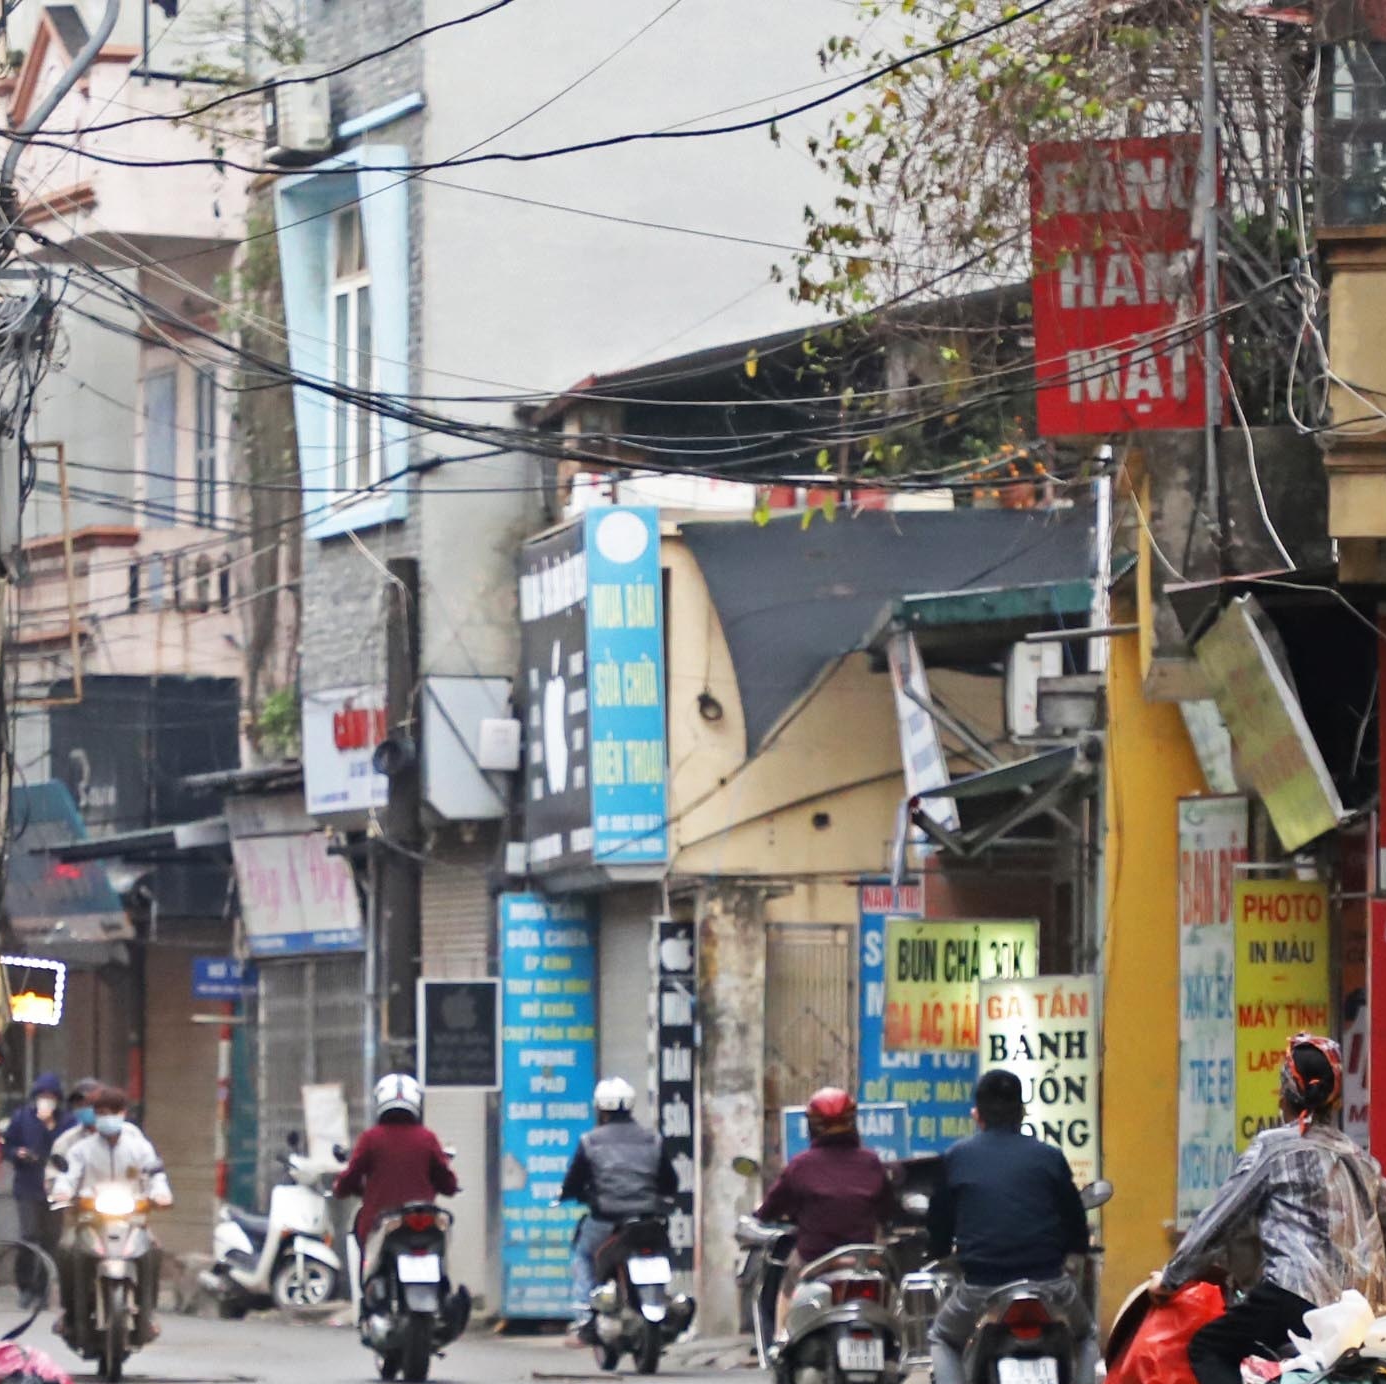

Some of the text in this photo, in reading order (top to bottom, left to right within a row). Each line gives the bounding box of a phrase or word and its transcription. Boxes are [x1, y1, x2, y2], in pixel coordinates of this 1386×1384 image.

[1242, 895, 1321, 923] PHOTO
[898, 928, 938, 982] BÚN
[944, 925, 980, 982] CHẢ
[1249, 936, 1315, 963] IN MÀU
[1238, 998, 1328, 1027] MÁY TÍNH
[989, 1024, 1088, 1062] BÁNH
[1021, 1063, 1088, 1105] UỐN
